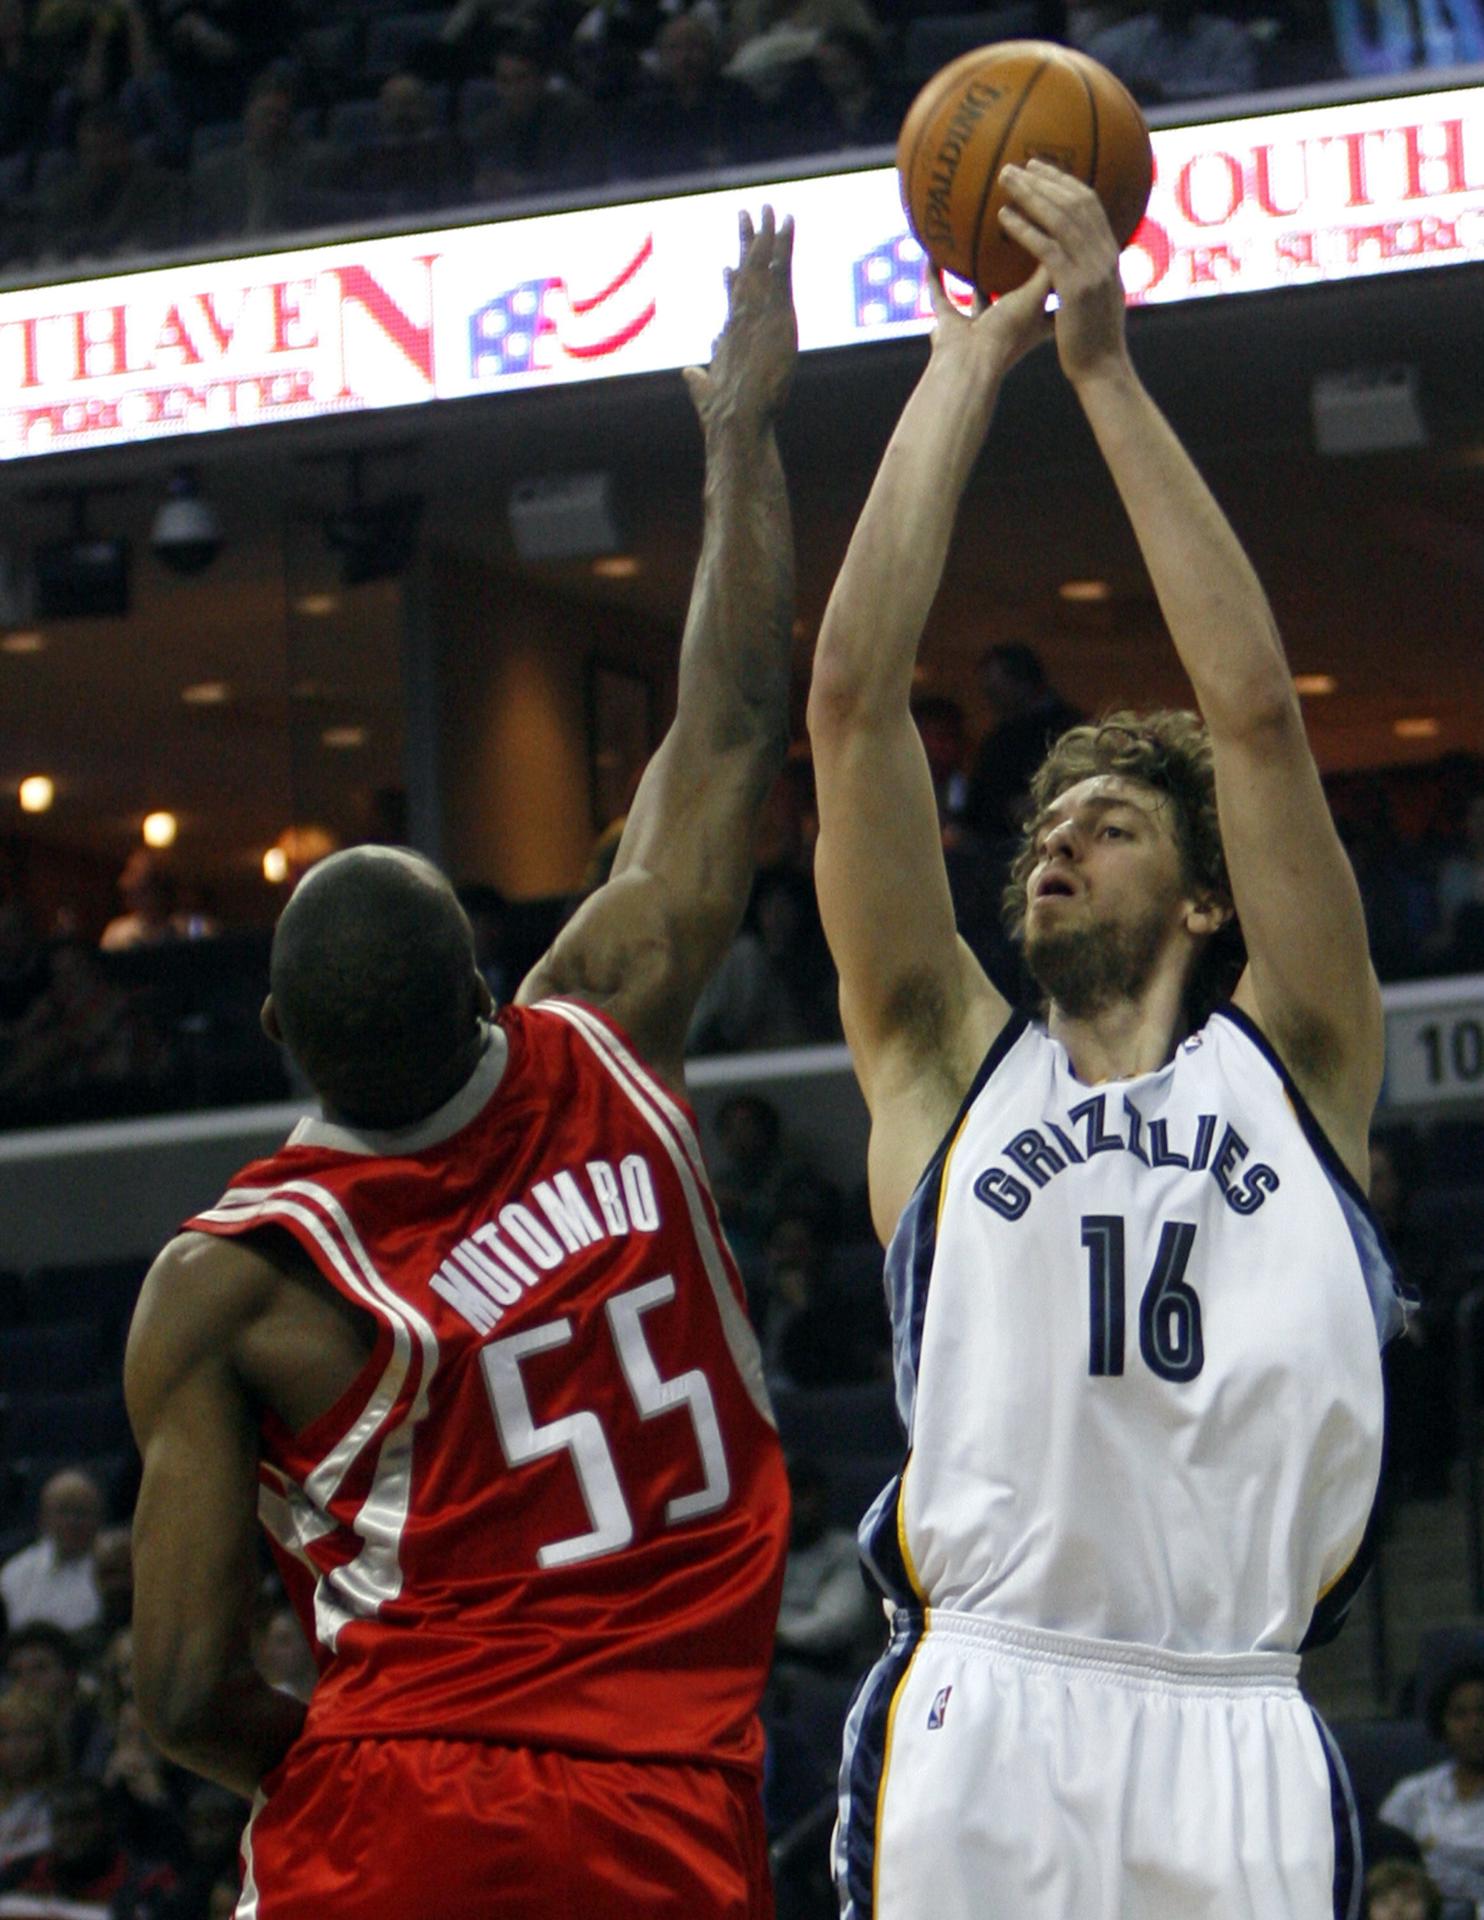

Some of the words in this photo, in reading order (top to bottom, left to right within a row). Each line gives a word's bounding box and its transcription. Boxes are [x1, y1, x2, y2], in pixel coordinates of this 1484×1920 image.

[923, 79, 1003, 249] SPALDING
[973, 1093, 1280, 1222] GRIZZLIES
[429, 1154, 660, 1337] MUTOMBO
[1081, 1215, 1205, 1384] 16
[479, 1273, 731, 1570] 55
